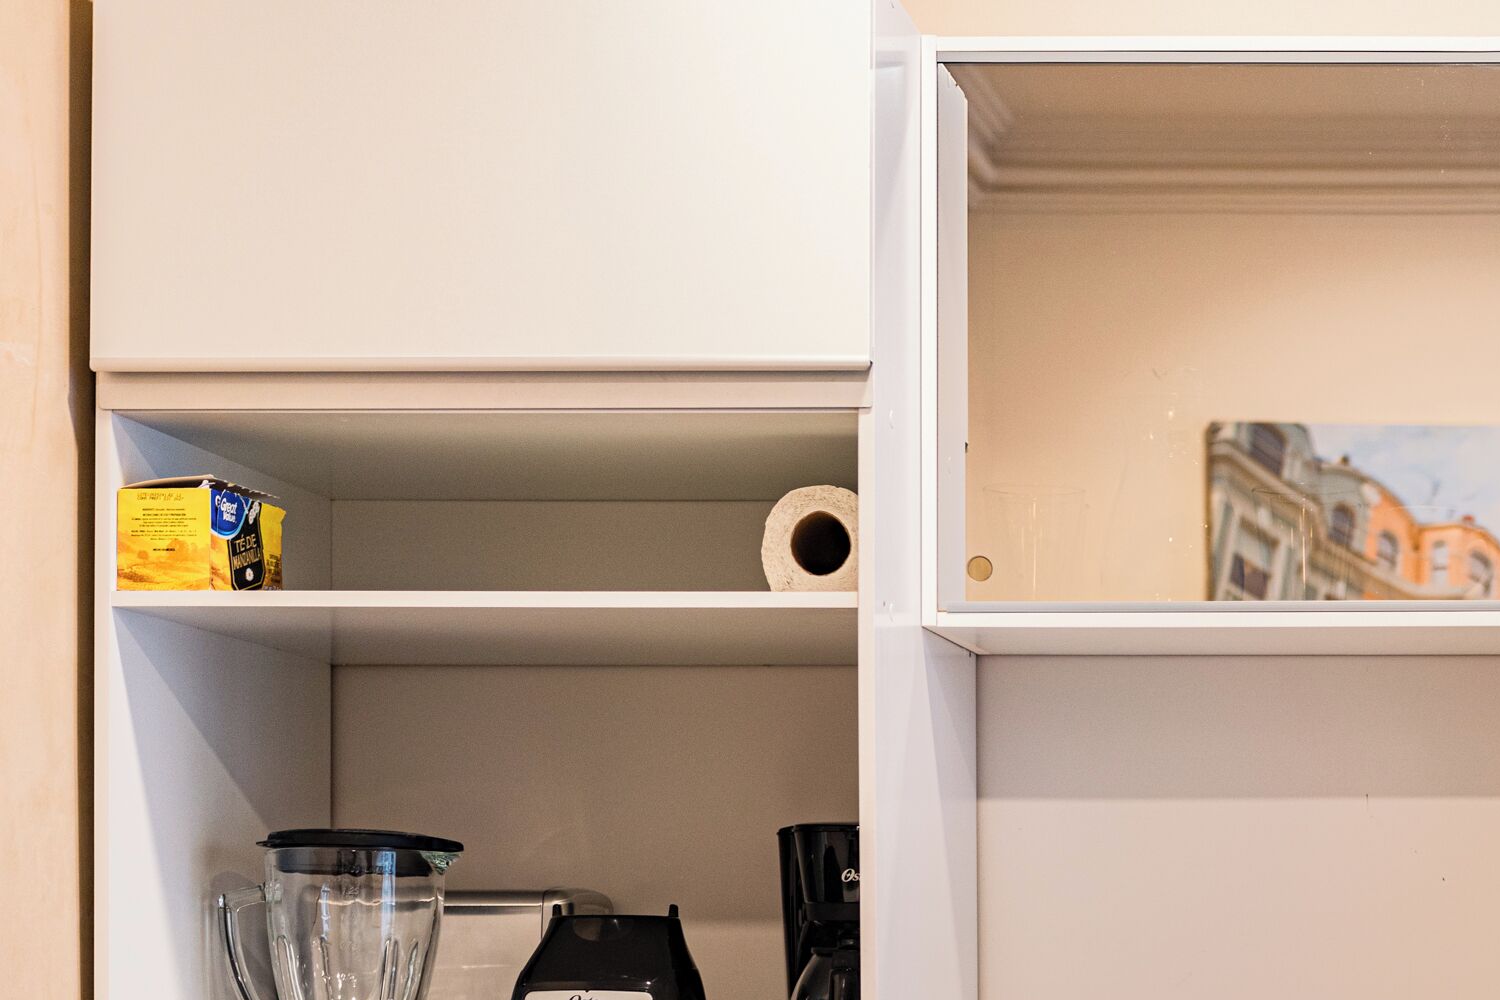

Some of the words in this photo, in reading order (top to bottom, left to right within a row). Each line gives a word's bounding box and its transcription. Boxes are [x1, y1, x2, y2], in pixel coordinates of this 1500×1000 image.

[220, 497, 238, 514] Great
[234, 534, 245, 553] TÉ
[246, 534, 257, 549] DE
